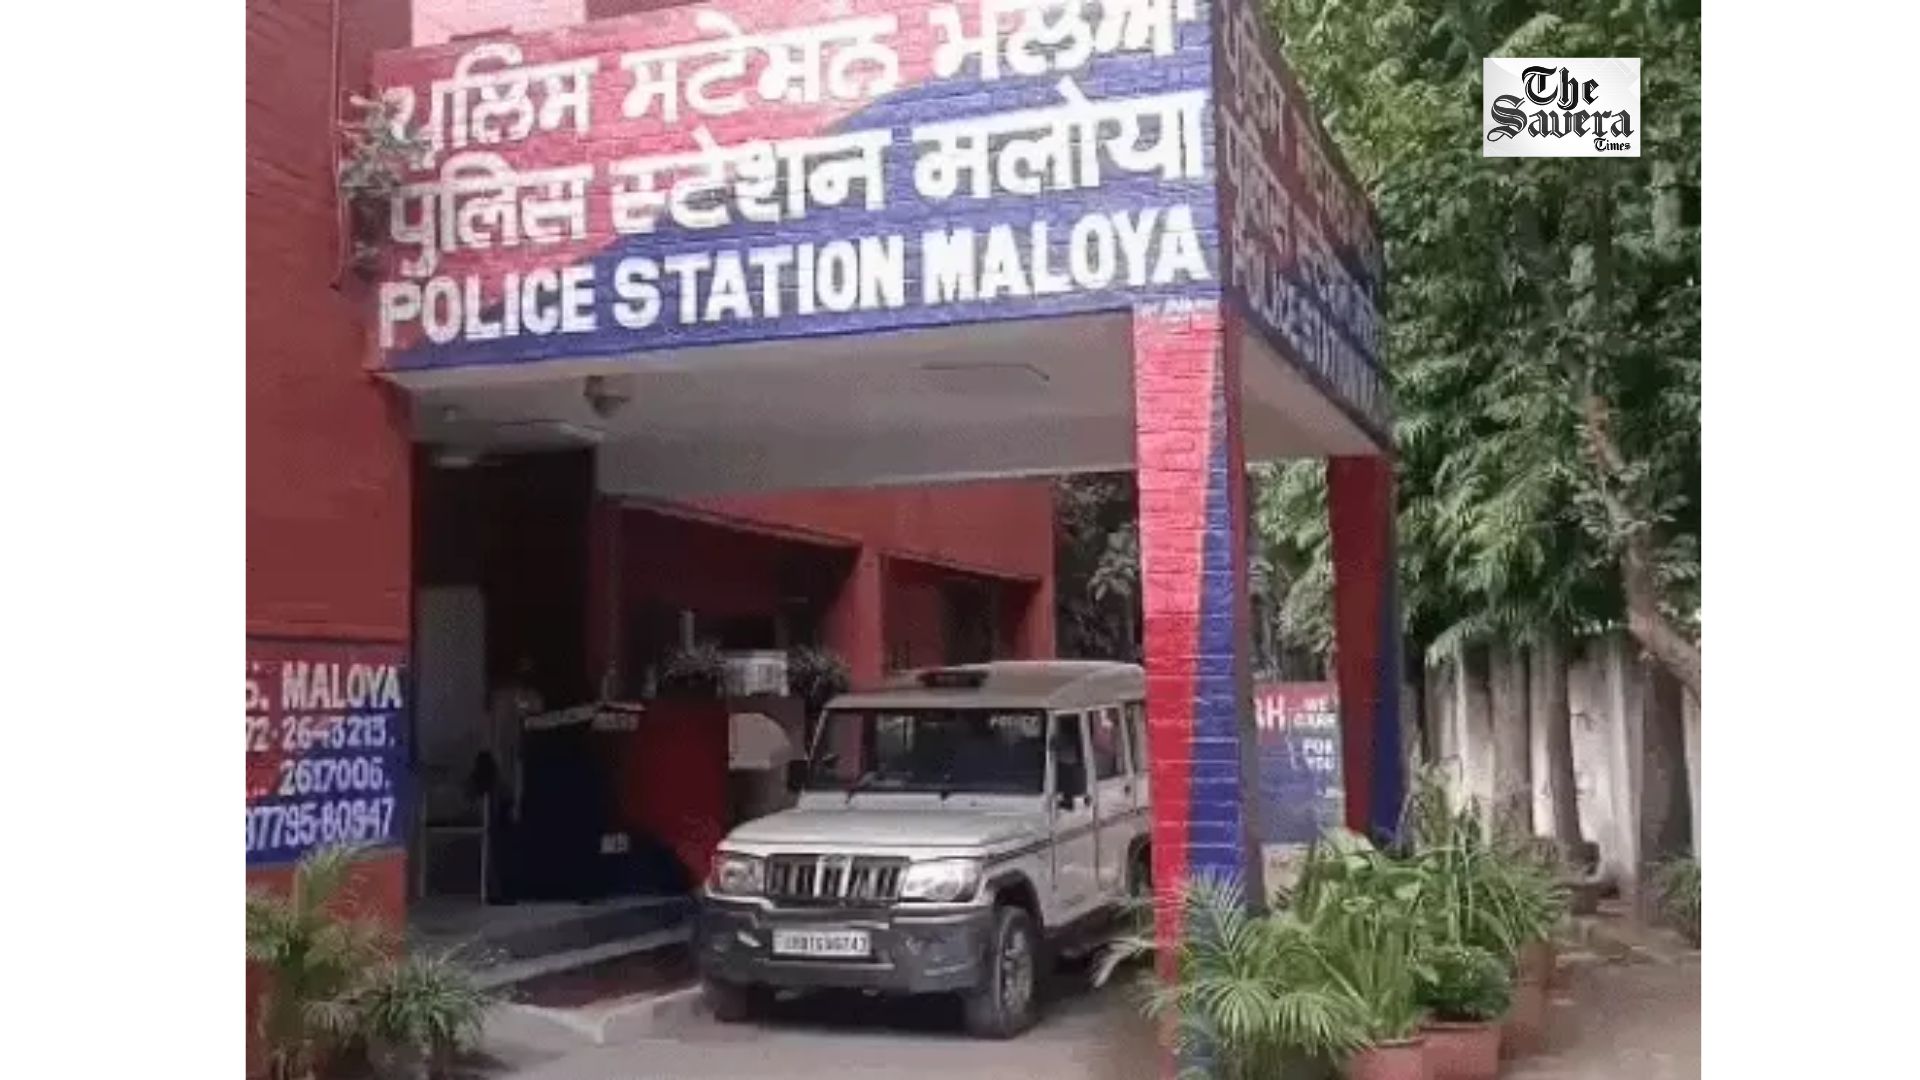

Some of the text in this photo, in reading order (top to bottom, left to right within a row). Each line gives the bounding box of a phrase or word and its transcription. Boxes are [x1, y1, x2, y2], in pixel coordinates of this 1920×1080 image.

[389, 150, 595, 277] पुलिस
[609, 125, 894, 234] स्टेशन
[913, 75, 1210, 198] मलोया
[378, 204, 1211, 349] POLICE STATION MALOYA
[282, 660, 402, 710] MALOYA
